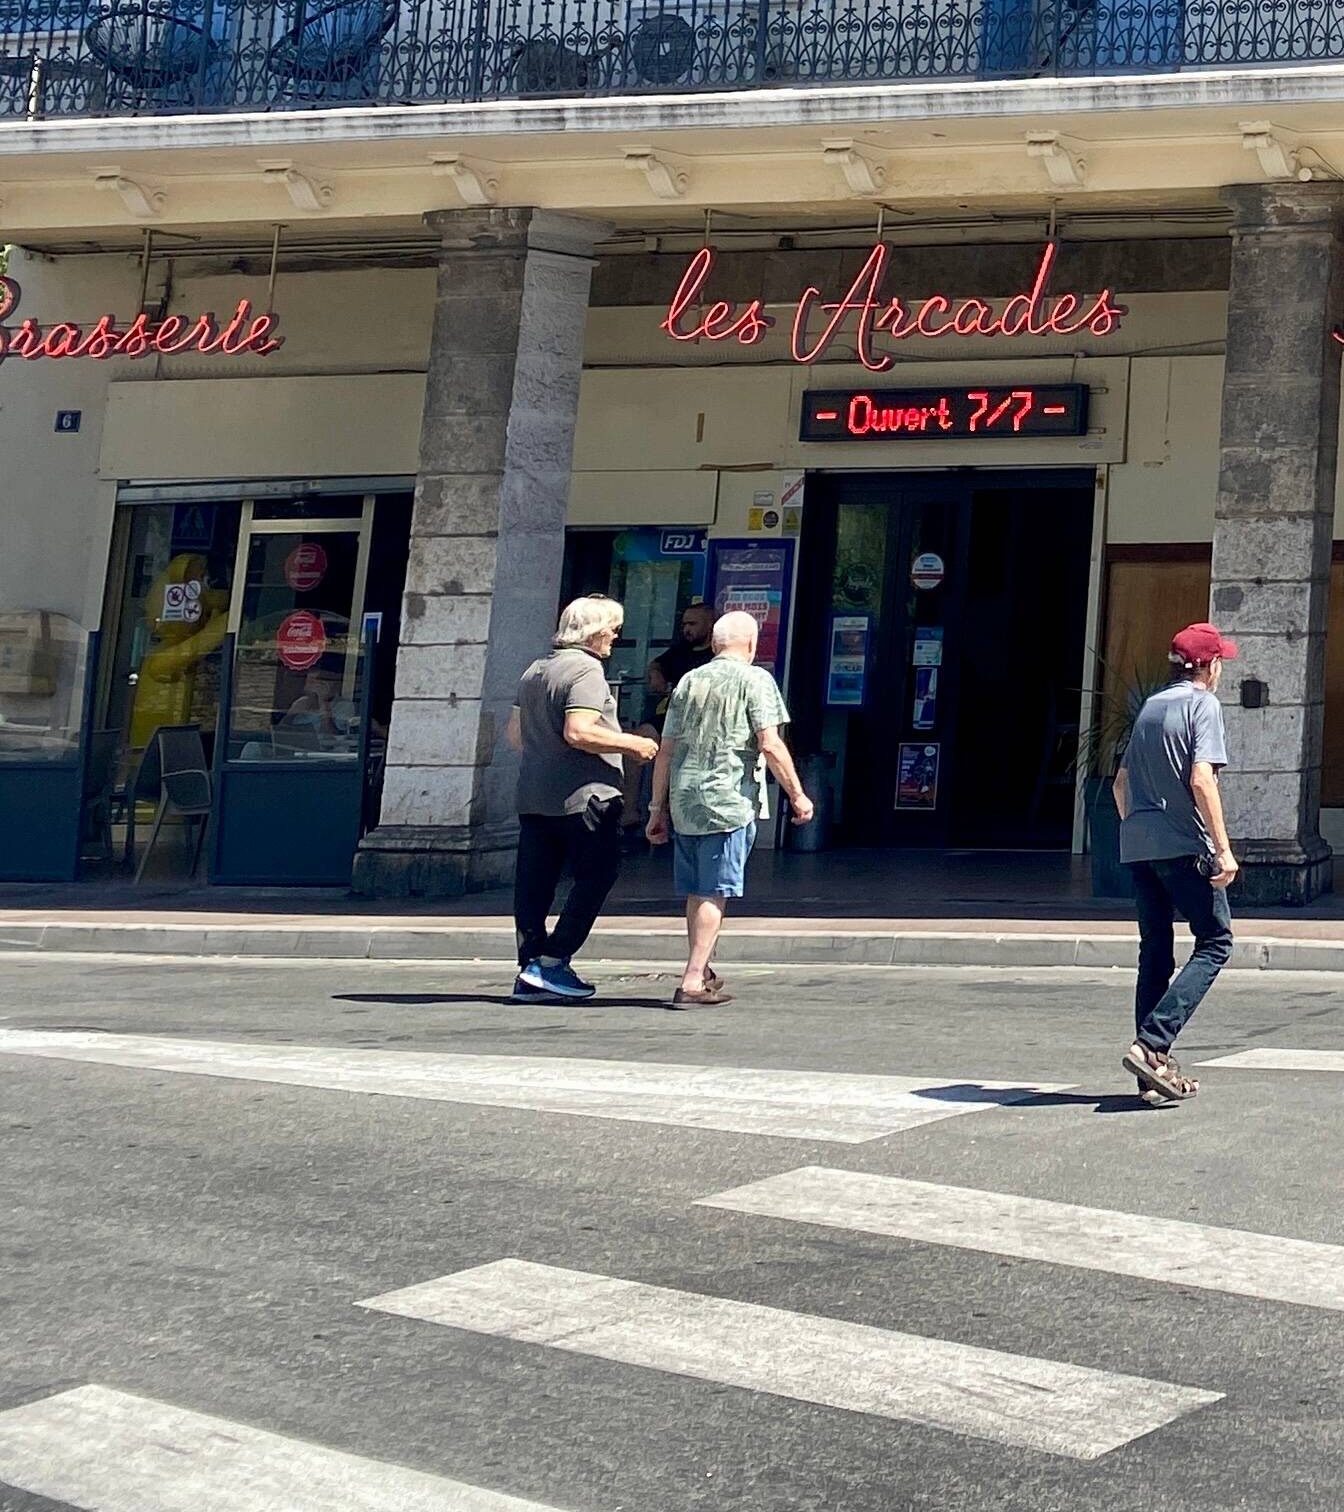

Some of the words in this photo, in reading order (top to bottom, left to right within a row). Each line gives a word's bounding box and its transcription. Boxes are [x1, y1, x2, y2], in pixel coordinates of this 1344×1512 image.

[659, 247, 772, 346] les
[791, 241, 1126, 371] Arcades
[62, 414, 72, 429] 6
[848, 395, 953, 434] Ouvert
[966, 391, 1033, 431] 7/7
[664, 534, 695, 549] FDJ
